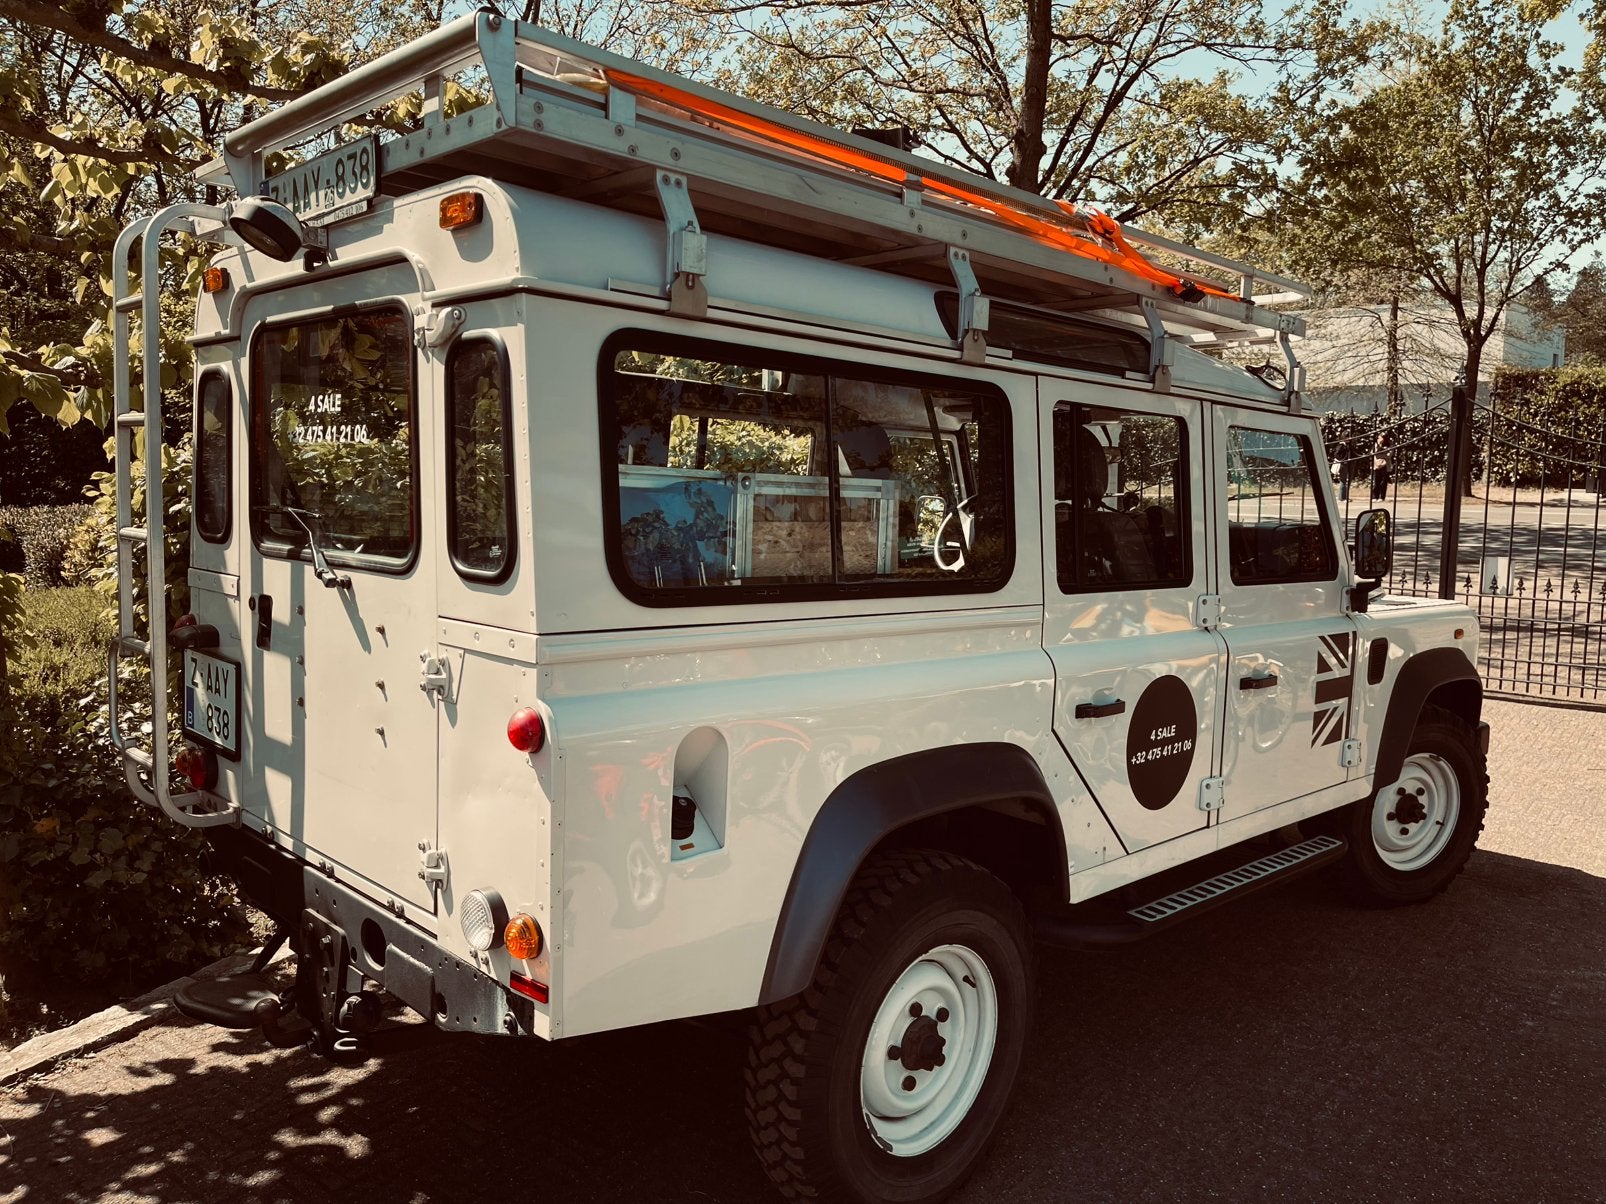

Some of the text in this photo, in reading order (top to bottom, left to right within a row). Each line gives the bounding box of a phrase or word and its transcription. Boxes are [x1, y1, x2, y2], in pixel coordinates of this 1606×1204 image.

[309, 394, 342, 413] 4 SALE
[306, 425, 323, 443] 475
[325, 425, 337, 442] 41
[340, 424, 351, 442] 21
[354, 424, 367, 443] 06
[187, 711, 193, 725] B
[206, 703, 230, 740] 838
[1150, 724, 1176, 741] 4 SALE
[1131, 738, 1192, 765] +32 475 41 21 06
